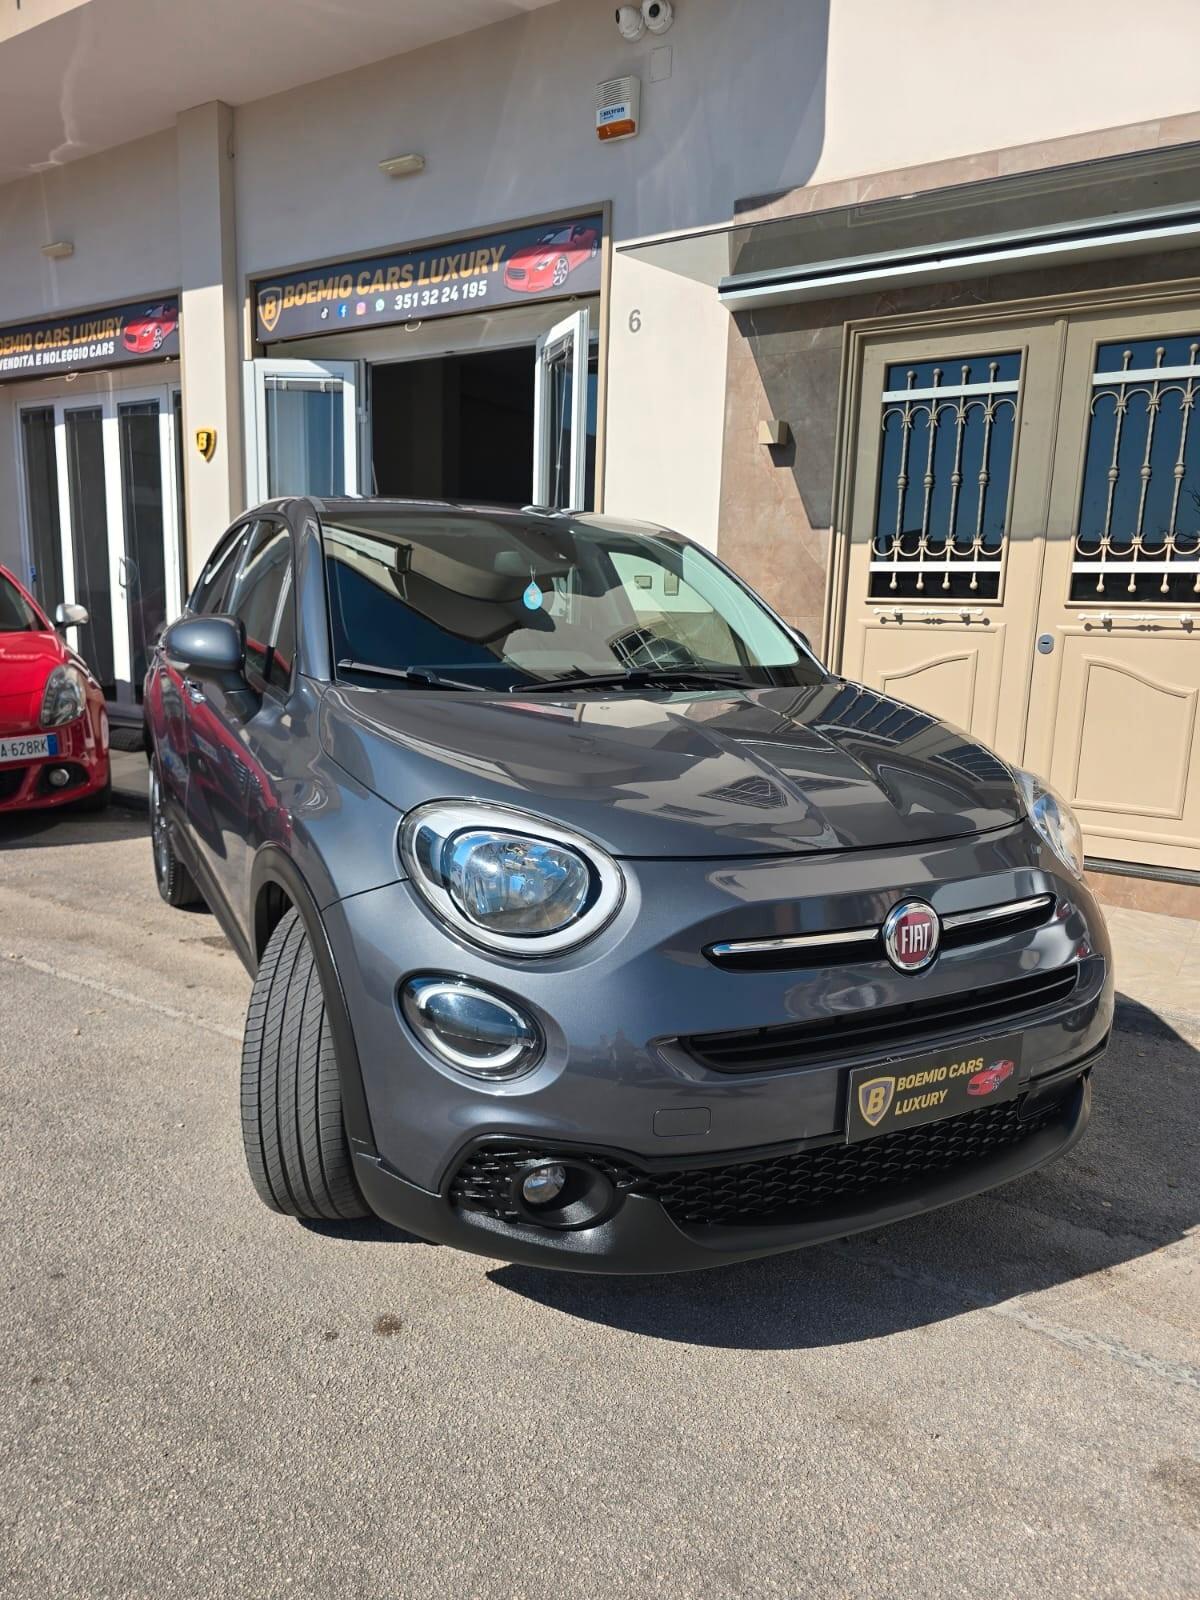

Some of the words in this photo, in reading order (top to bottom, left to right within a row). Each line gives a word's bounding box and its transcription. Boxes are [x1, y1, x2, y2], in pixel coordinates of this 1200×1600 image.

[282, 274, 353, 309] BOEMIO
[356, 263, 414, 295] CARS
[417, 244, 506, 286] LUXURY
[264, 295, 277, 321] B
[394, 292, 419, 310] 351
[421, 288, 439, 306] 32
[441, 285, 459, 303] 24
[462, 279, 487, 299] 195
[35, 327, 70, 350] CARS
[72, 316, 123, 345] LUXURY
[629, 309, 641, 333] 6
[35, 353, 42, 366] E
[43, 346, 88, 365] NOLEGGIO
[89, 341, 114, 358] CARS
[901, 922, 930, 954] FIAT
[896, 1066, 947, 1092] BOEMIO
[949, 1057, 984, 1078] CARS
[867, 1086, 885, 1115] B
[895, 1089, 949, 1116] LUXURY
